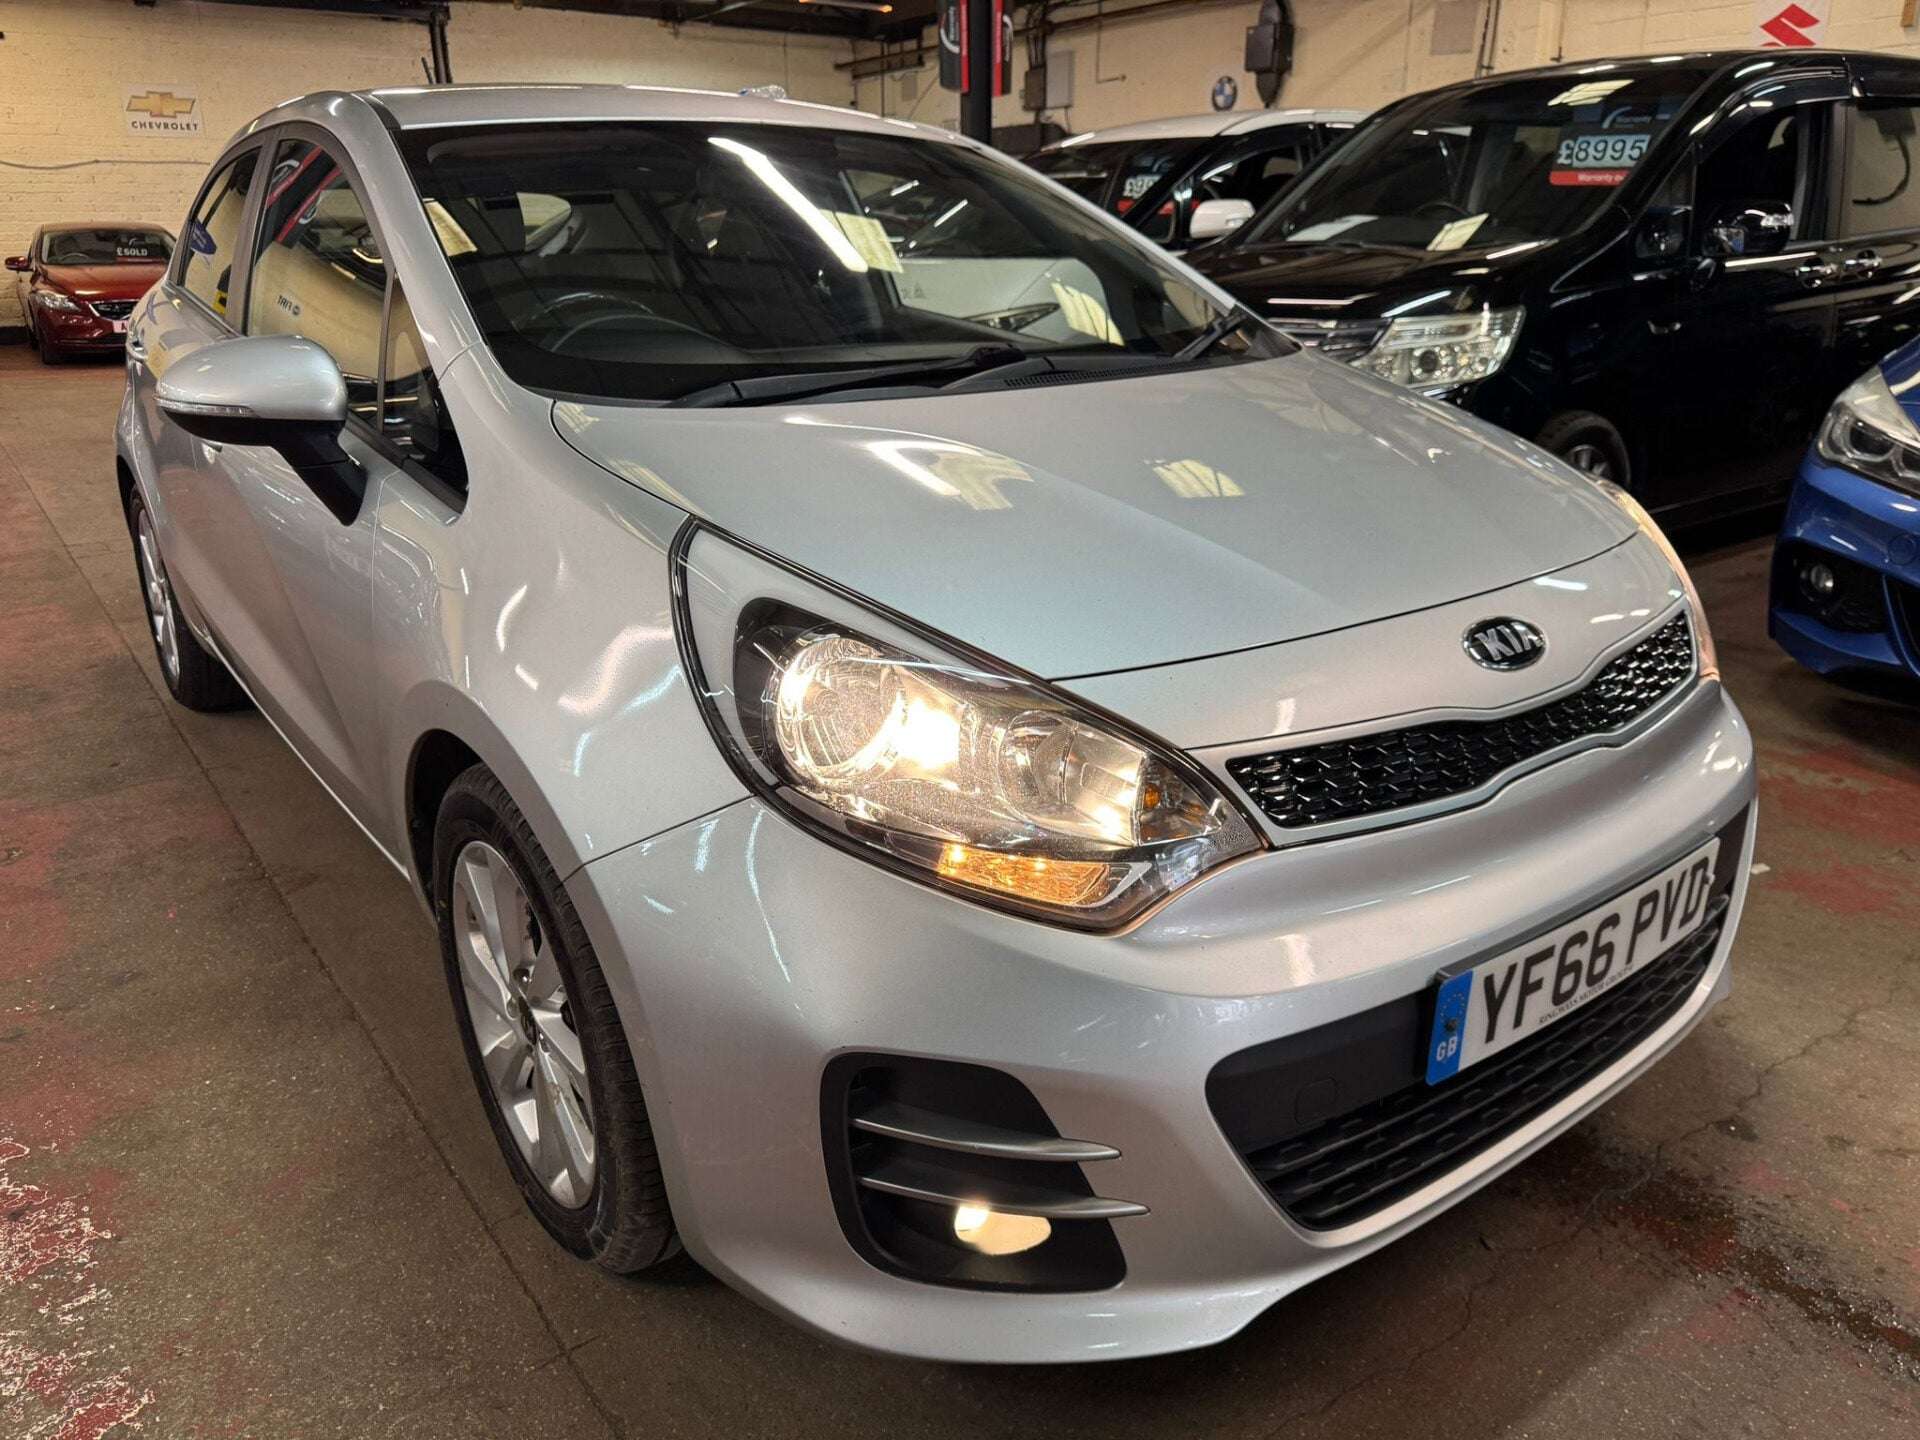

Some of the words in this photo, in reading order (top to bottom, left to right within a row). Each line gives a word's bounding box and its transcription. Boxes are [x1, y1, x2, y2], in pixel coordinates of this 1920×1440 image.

[131, 121, 198, 131] CHEVROLET
[1557, 138, 1645, 165] £8995
[1474, 622, 1542, 661] KIA
[1483, 912, 1621, 1045] YF66
[1625, 856, 1710, 966] PVD
[1436, 1036, 1458, 1062] GB
